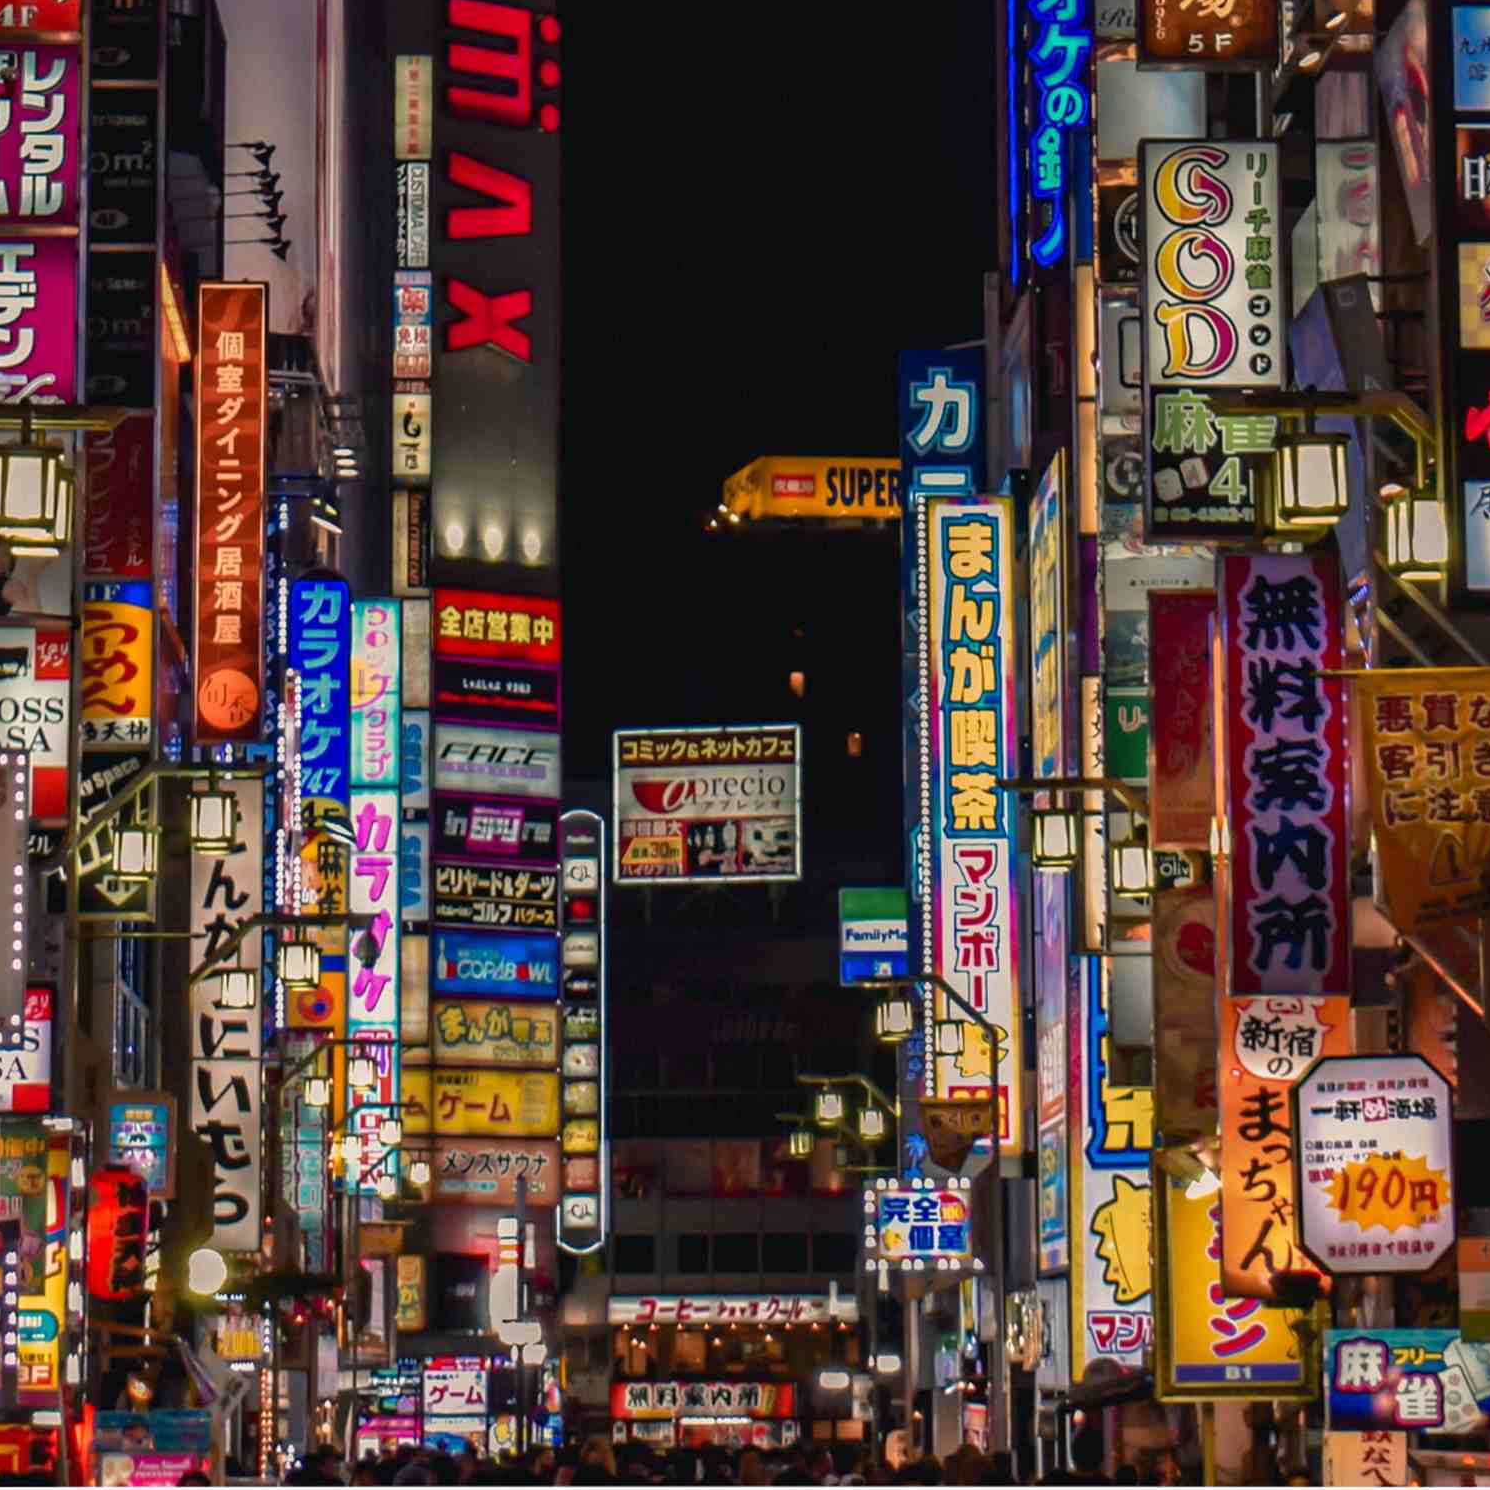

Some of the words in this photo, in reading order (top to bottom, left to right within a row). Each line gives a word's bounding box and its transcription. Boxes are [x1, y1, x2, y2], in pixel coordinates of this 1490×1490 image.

[19, 50, 66, 216] レンタル
[213, 330, 247, 645] 個室ダイニング居酒屋
[298, 583, 343, 762] カラオケ
[957, 849, 996, 1010] マンボー
[1338, 1166, 1439, 1212] 190円
[1392, 1347, 1444, 1366] フリー
